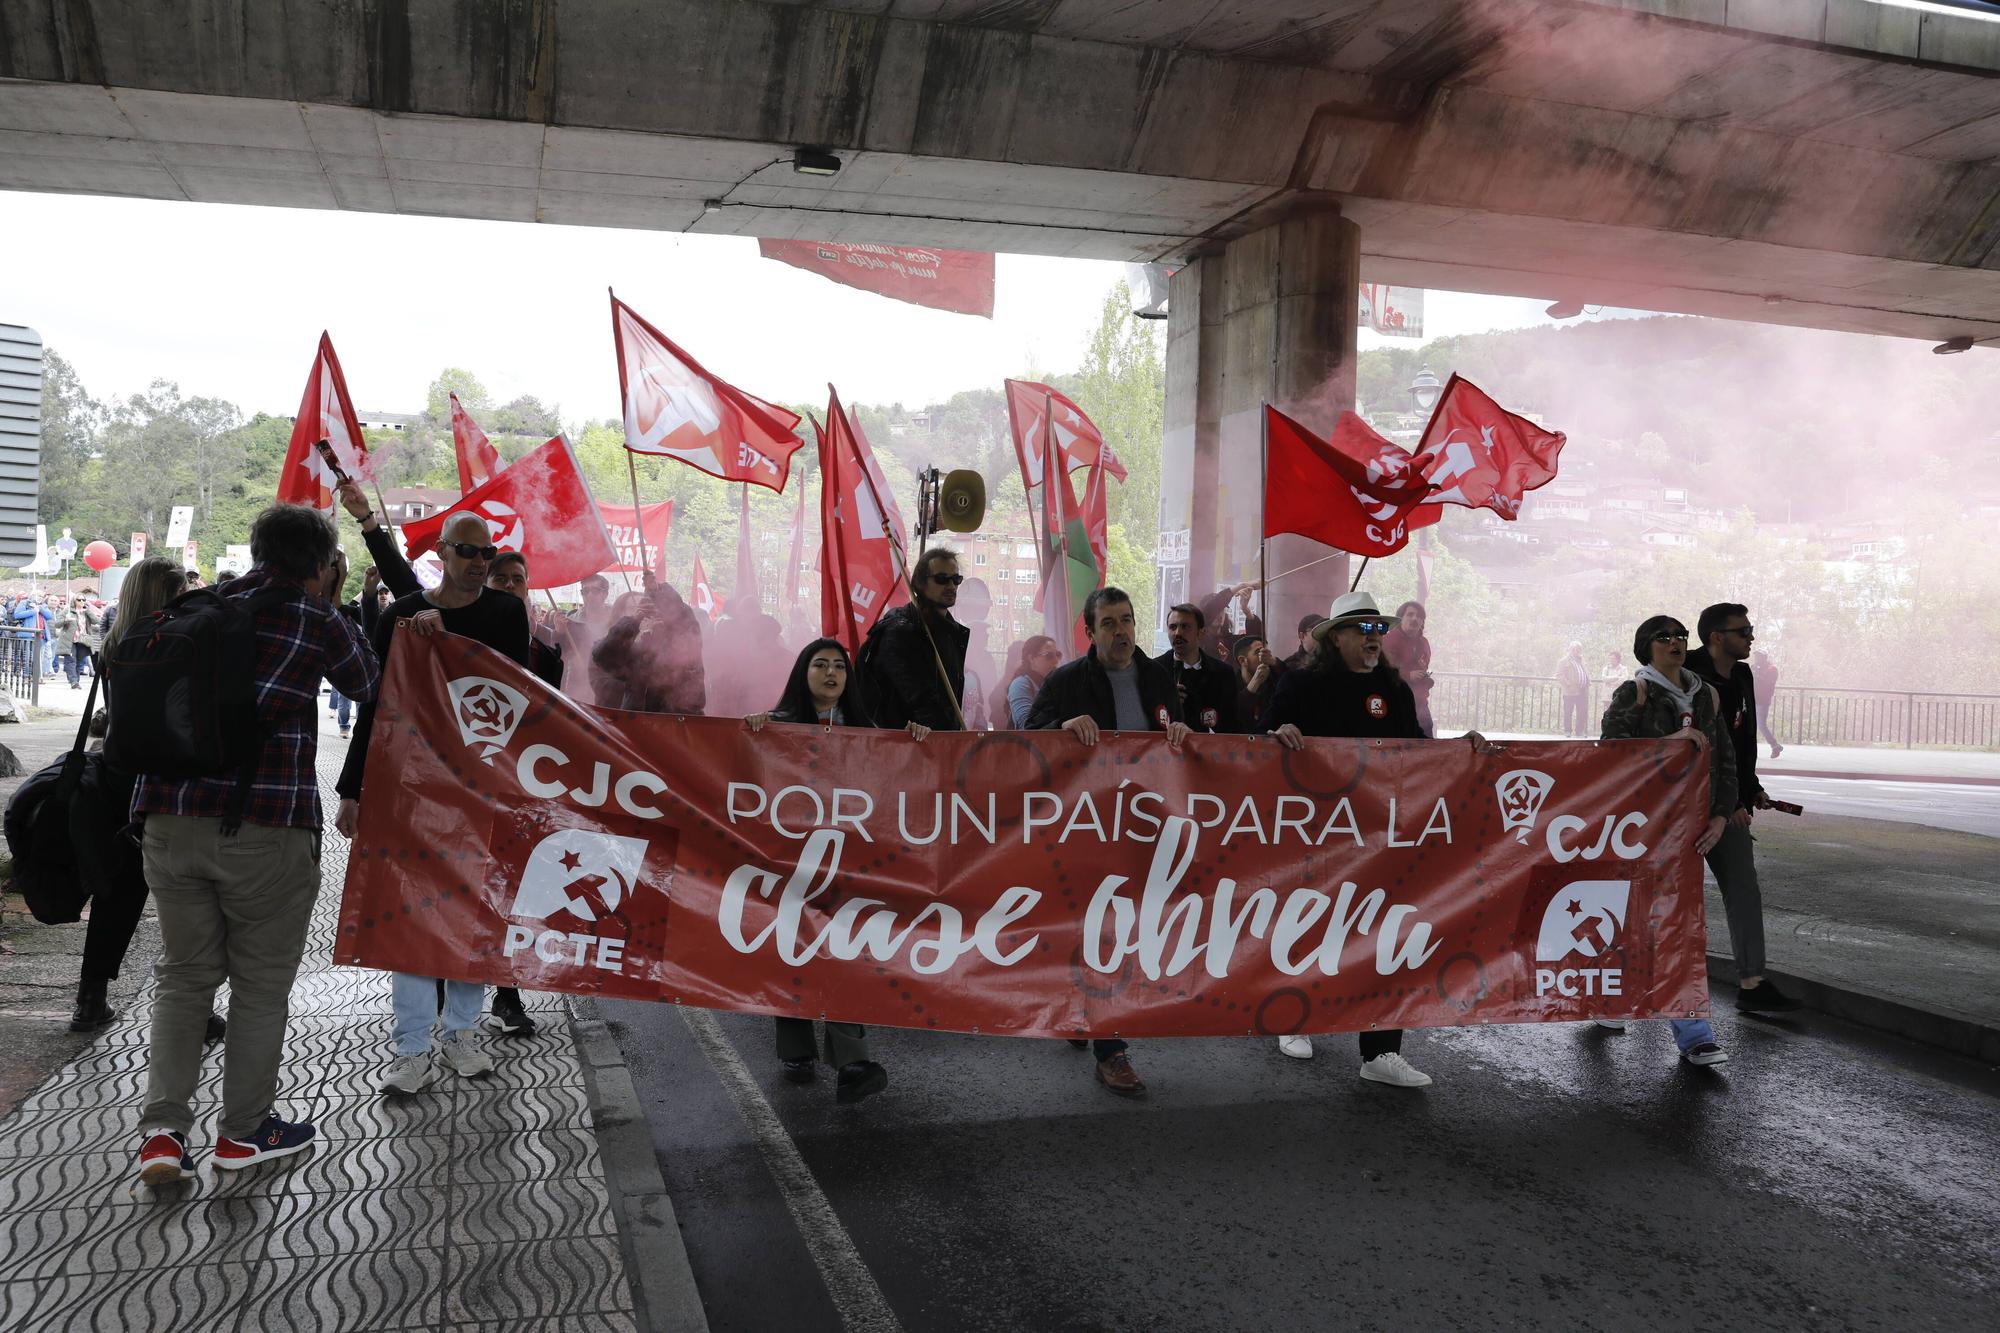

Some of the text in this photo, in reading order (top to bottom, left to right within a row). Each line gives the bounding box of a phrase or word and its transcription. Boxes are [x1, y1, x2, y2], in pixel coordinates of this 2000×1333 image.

[517, 743, 669, 818] CJC
[727, 778, 1453, 848] POR UN PAÍS PARA LA
[1545, 811, 1649, 864] CJC
[719, 815, 1444, 982] clase obrera
[502, 924, 626, 971] PCTE
[1535, 968, 1622, 997] PCTE
